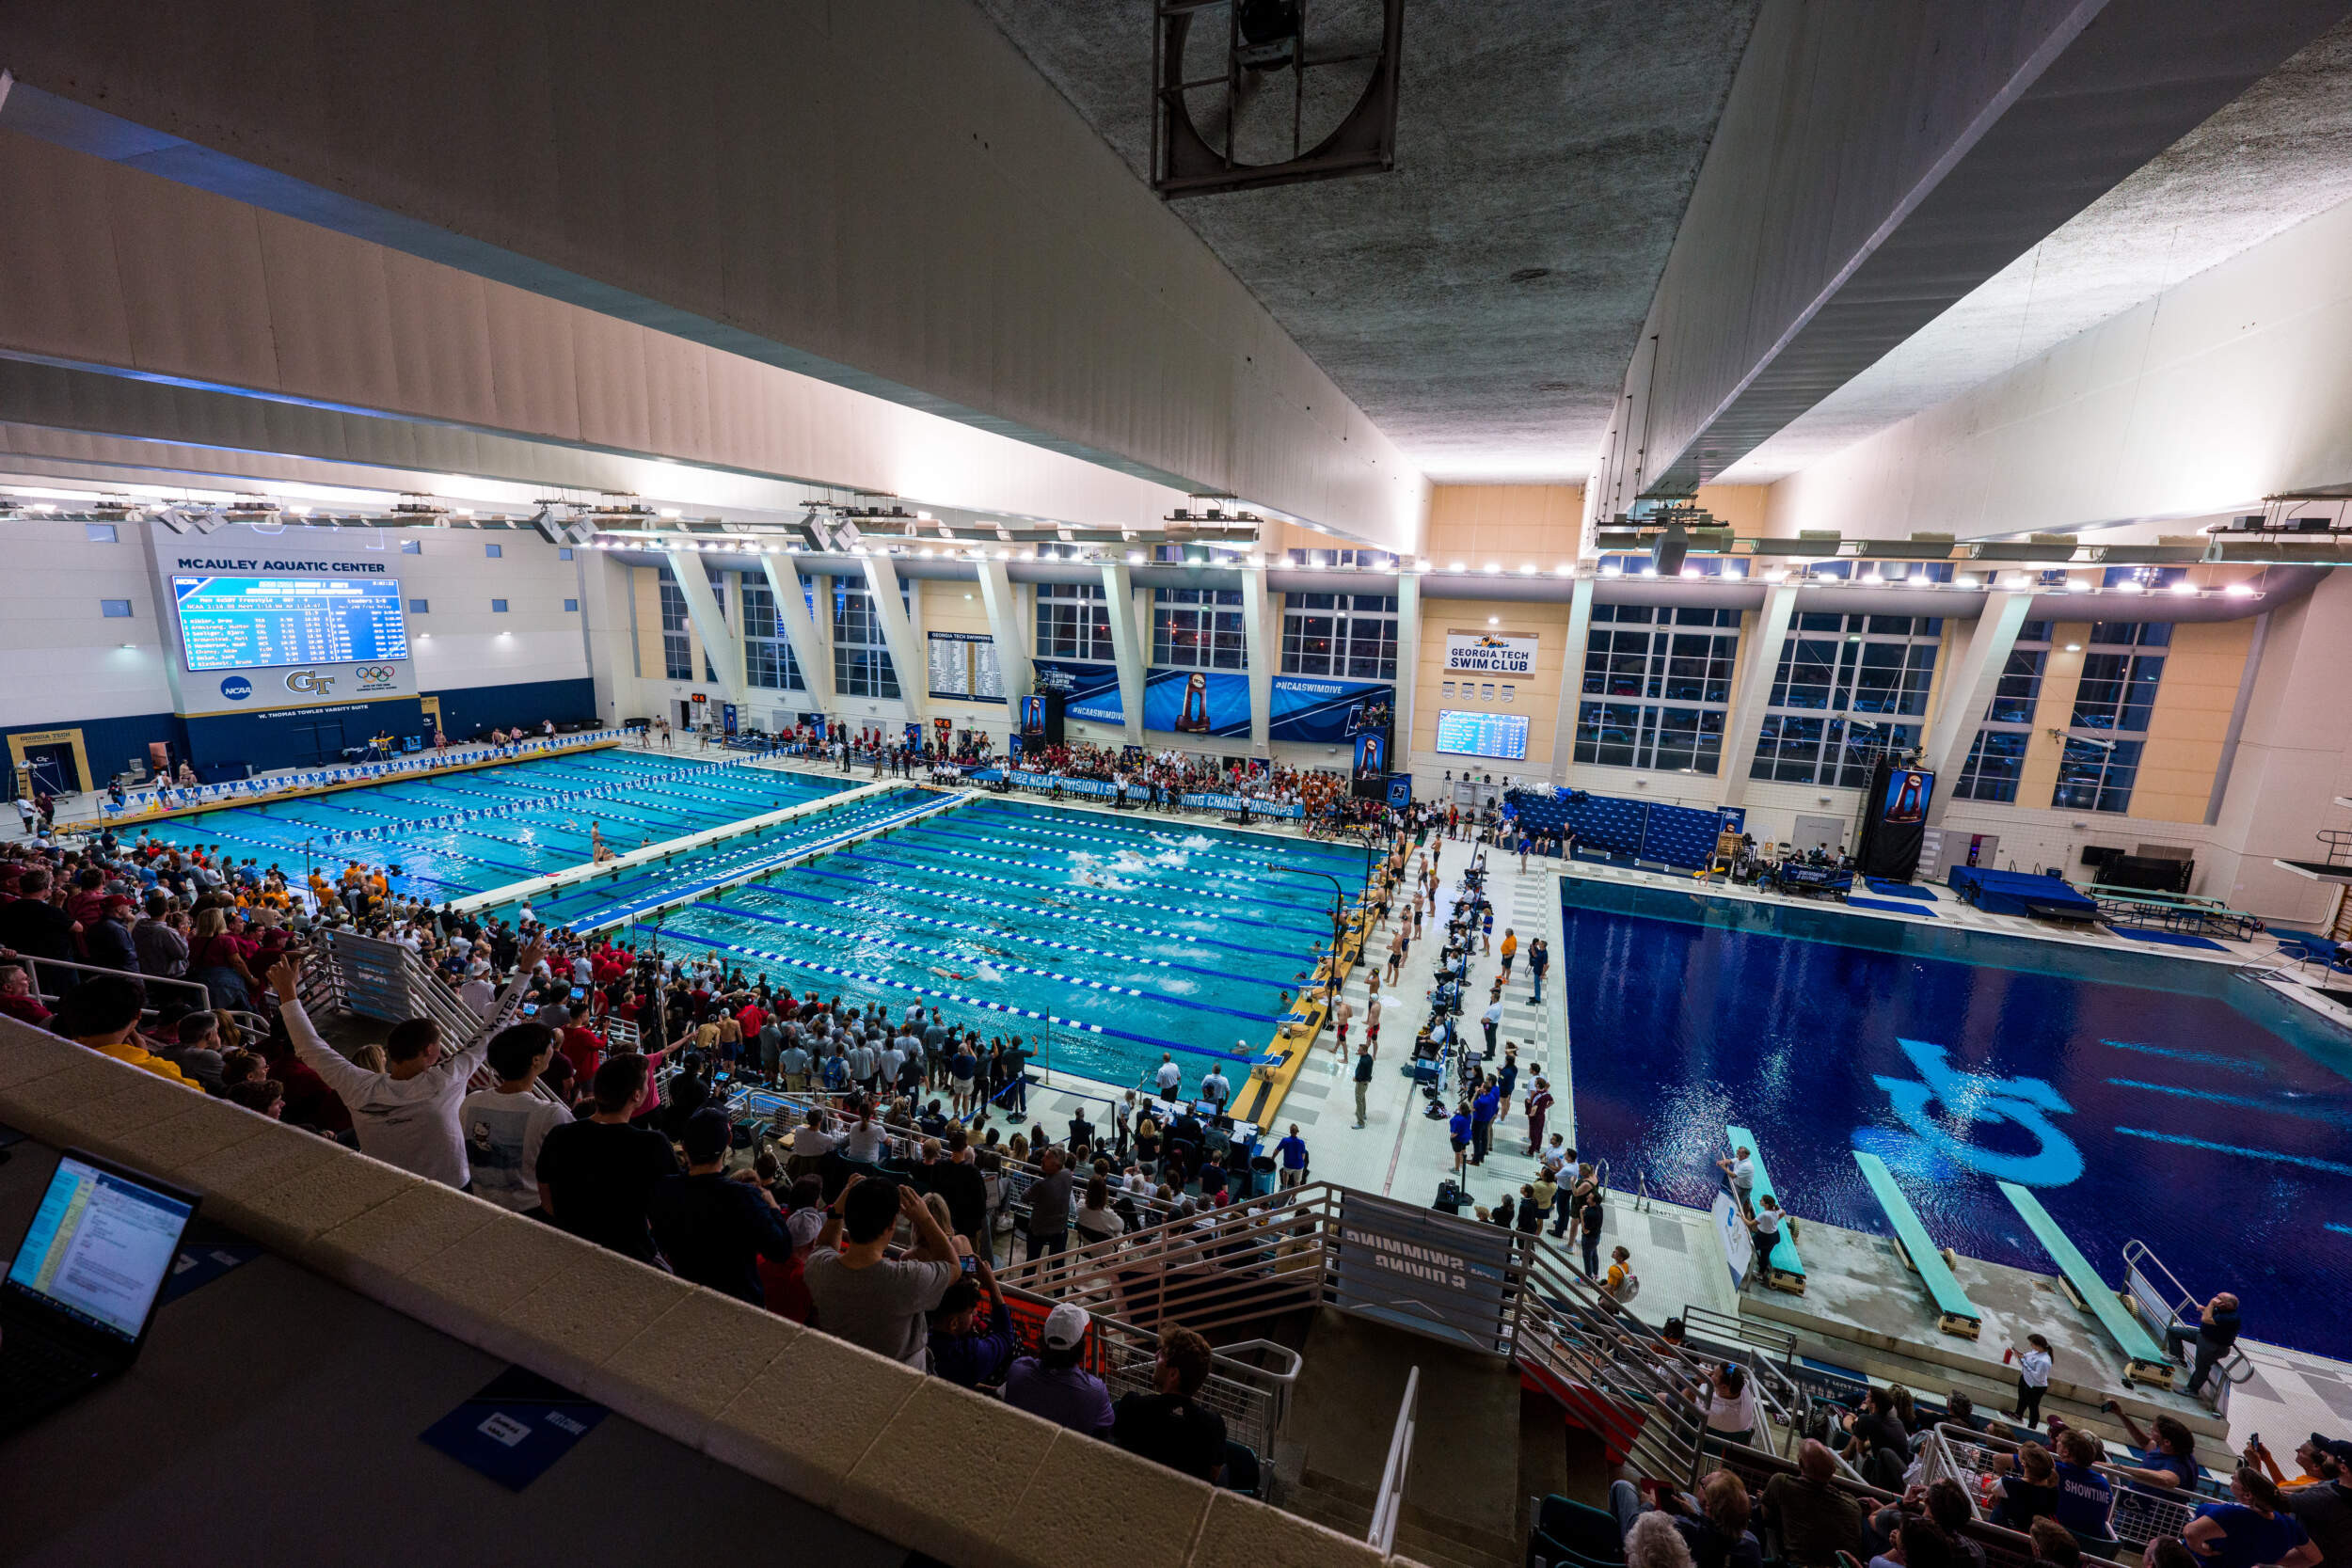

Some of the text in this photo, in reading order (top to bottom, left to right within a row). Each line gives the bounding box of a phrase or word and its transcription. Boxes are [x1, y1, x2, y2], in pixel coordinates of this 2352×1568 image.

[178, 559, 385, 572] MCAULEY AQUATIC CENTER
[1452, 648, 1529, 659] GEORGIA TECH
[1451, 657, 1528, 671] SWIM CLUB
[1276, 681, 1343, 694] #NCAASWIMDIVE
[1030, 775, 1053, 788] NCAA
[484, 992, 520, 1032] WATER
[2064, 1479, 2110, 1505] SHOWTIME
